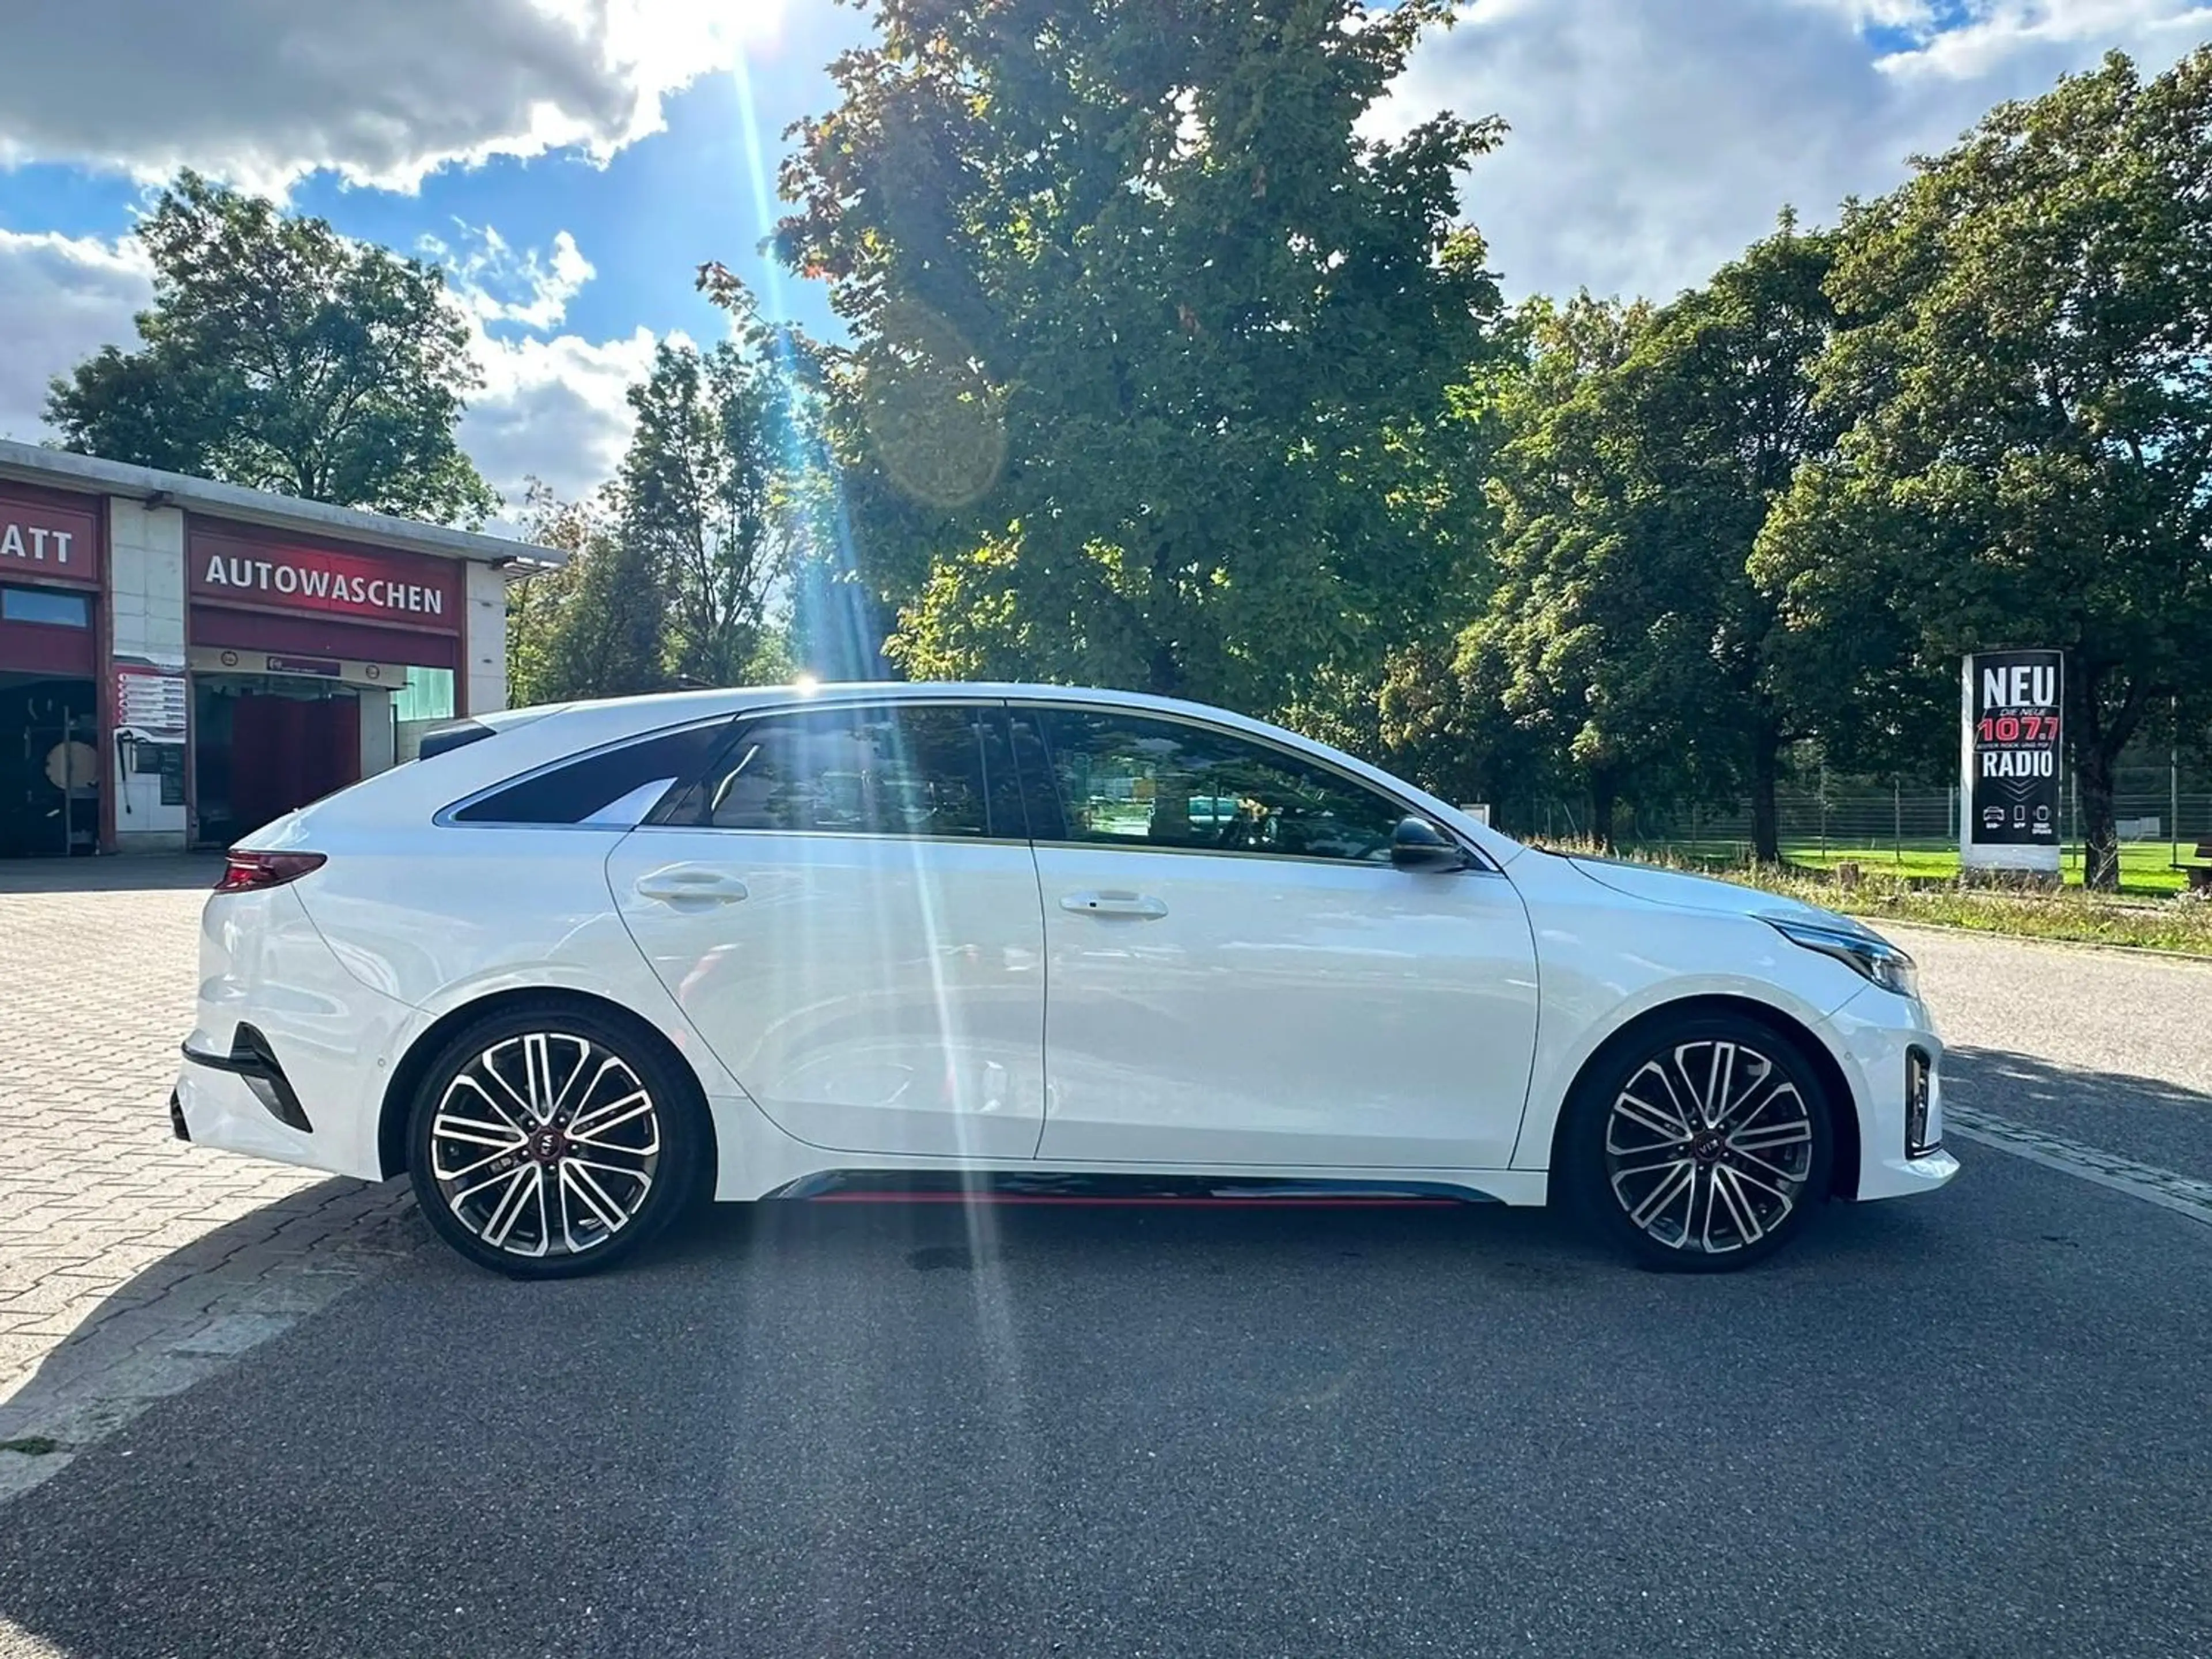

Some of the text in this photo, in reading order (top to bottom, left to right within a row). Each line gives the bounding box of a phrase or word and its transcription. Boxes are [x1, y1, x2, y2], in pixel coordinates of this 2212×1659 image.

[205, 555, 442, 614] AUTOWASCHEN
[1983, 666, 2055, 708] NEU
[1977, 717, 2059, 741] 107.7
[1983, 751, 2053, 777] RADIO
